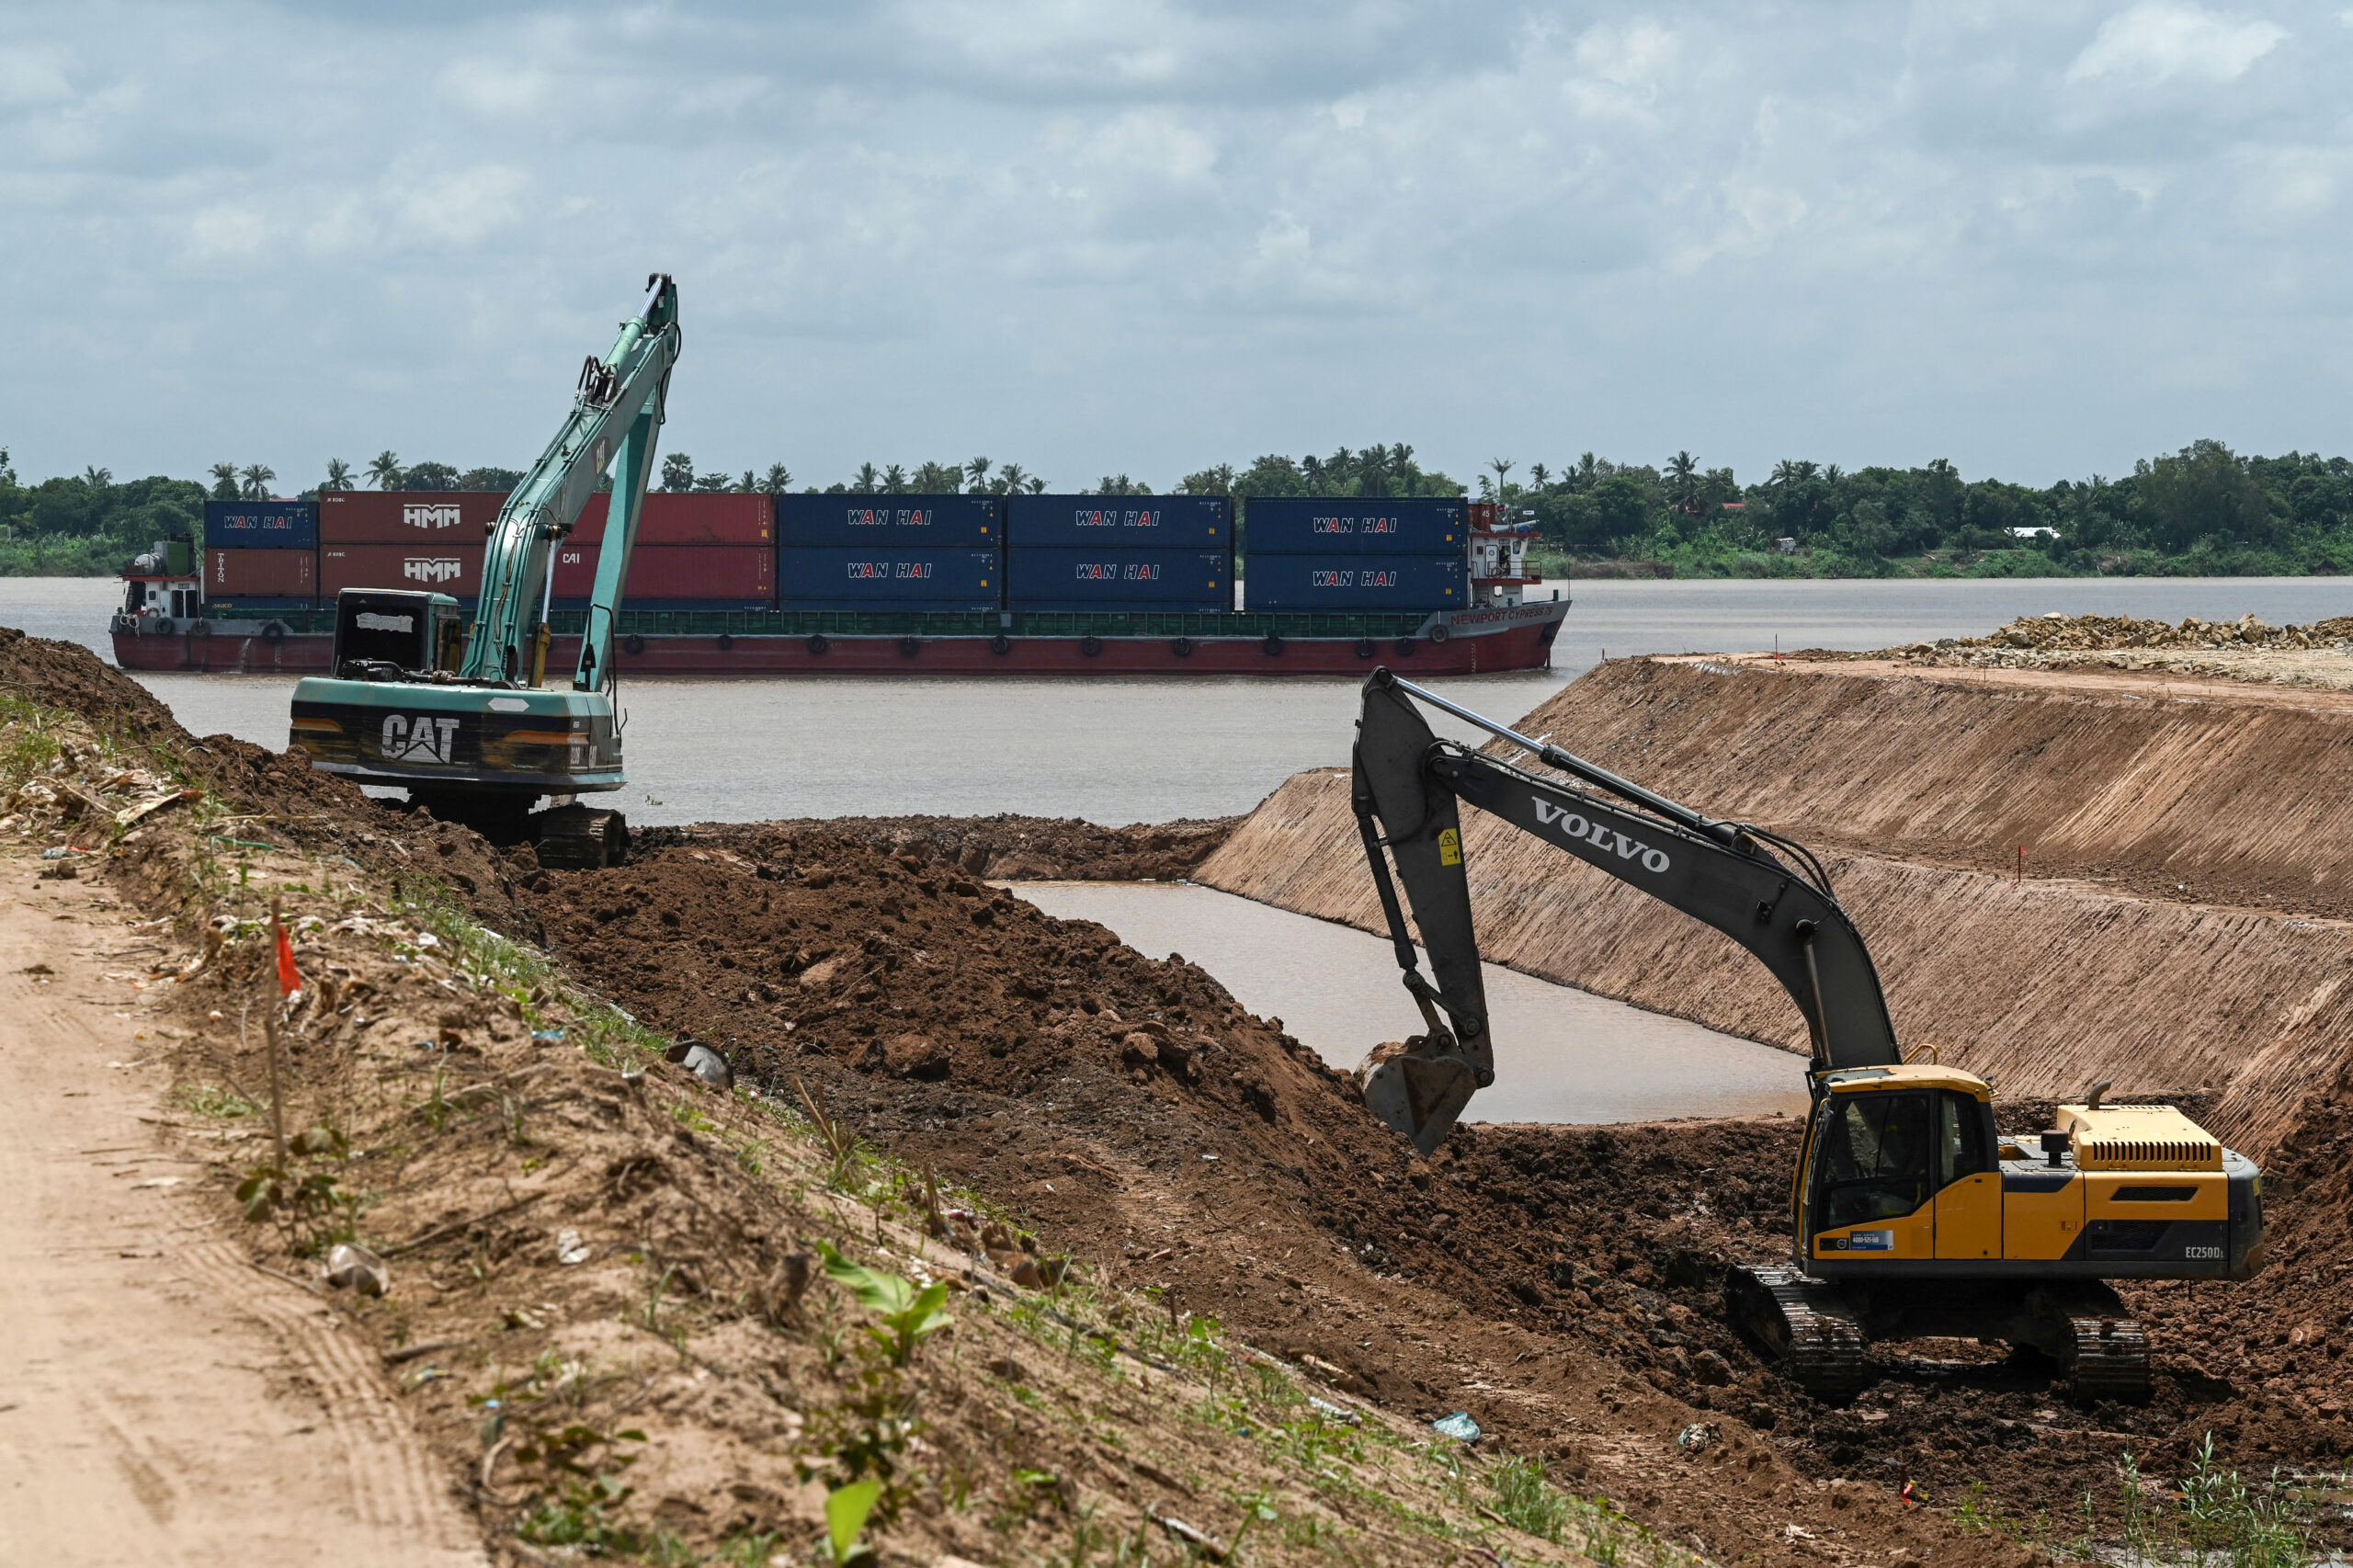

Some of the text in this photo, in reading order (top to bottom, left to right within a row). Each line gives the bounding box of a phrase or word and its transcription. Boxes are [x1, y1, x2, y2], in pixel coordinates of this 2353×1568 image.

[597, 438, 606, 473] CAT
[224, 516, 292, 528] WAN HAI
[404, 507, 460, 529] HMM
[847, 509, 932, 526] WAN HAI
[1075, 510, 1160, 527] WAN HAI
[1313, 517, 1397, 533] WAN HAI
[563, 553, 579, 563] CAI
[217, 552, 225, 583] TRITON
[404, 562, 461, 584] HMM
[847, 562, 932, 579] WAN HAI
[1075, 563, 1160, 580] WAN HAI
[1313, 571, 1397, 586] WAN HAI
[1450, 610, 1507, 626] NEWPORT
[1508, 608, 1545, 620] CYPRESS
[381, 714, 460, 764] CAT
[1531, 796, 1670, 873] VOLVO
